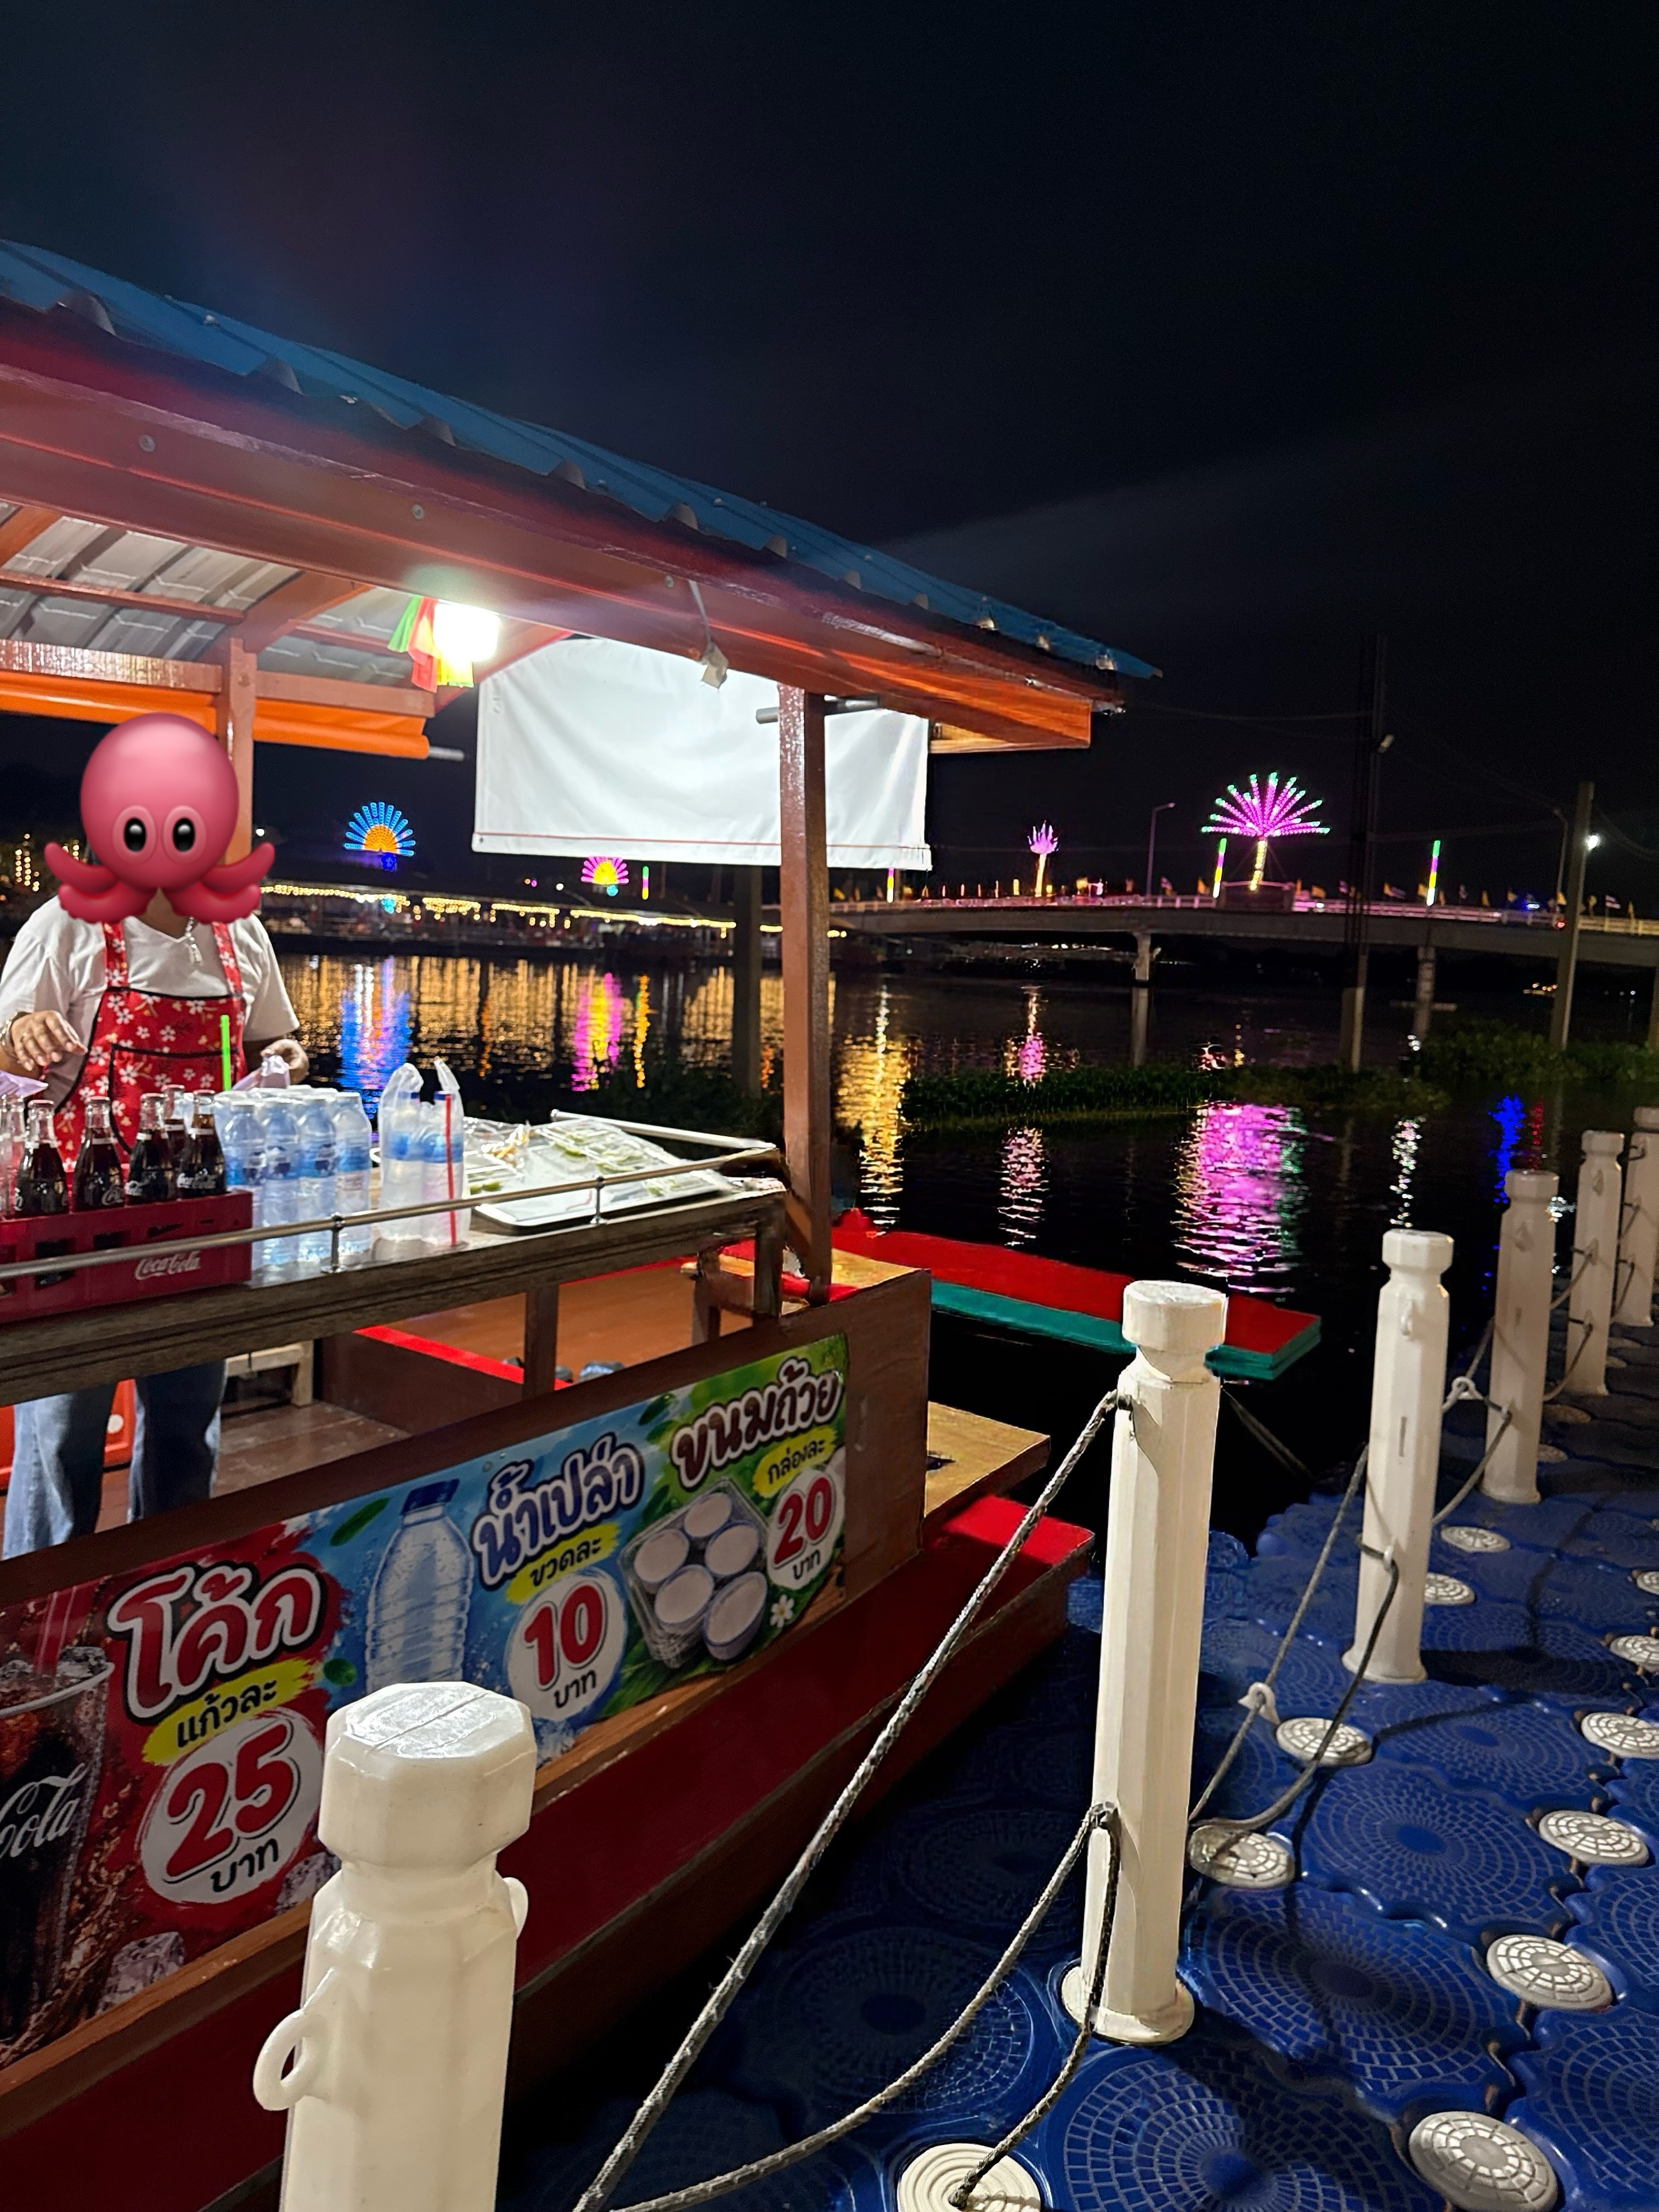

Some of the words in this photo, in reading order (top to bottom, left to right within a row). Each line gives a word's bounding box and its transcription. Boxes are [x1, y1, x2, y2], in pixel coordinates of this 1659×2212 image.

[135, 1251, 201, 1280] Coca-Cola
[671, 1356, 845, 1487] ขนมถ้วย
[767, 1436, 826, 1485] กล่องละ
[473, 1432, 644, 1587] น้ำเปล่า
[772, 1476, 833, 1567] 20
[531, 1537, 602, 1587] ขวดละ
[793, 1548, 821, 1580] บาท
[109, 1566, 323, 1719] โค้ก
[524, 1583, 605, 1690] 10
[177, 1678, 276, 1748] แก้วละ
[554, 1671, 596, 1707] บาท
[167, 1718, 296, 1877] 25
[211, 1837, 279, 1892] บาท
